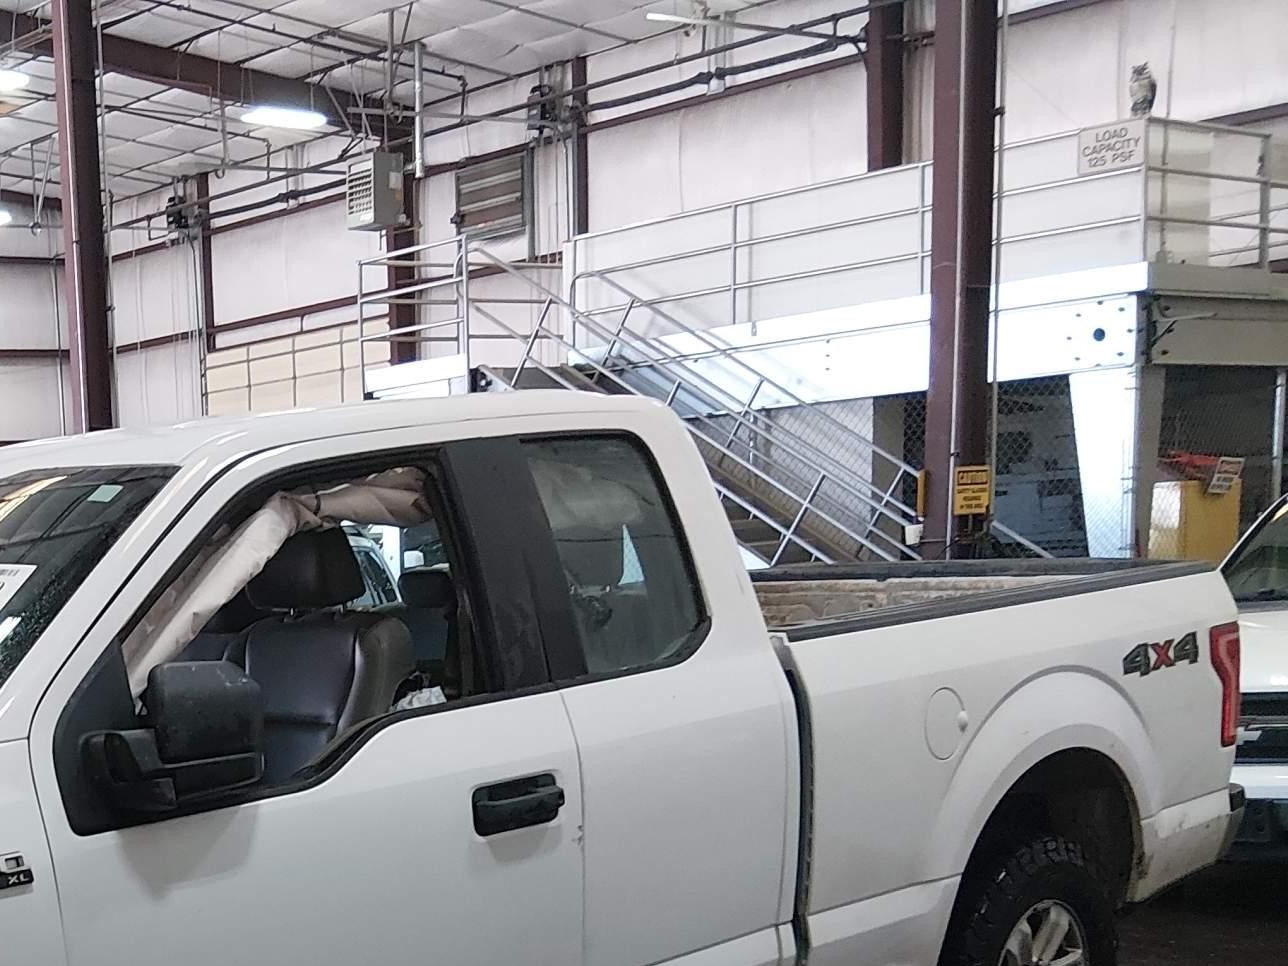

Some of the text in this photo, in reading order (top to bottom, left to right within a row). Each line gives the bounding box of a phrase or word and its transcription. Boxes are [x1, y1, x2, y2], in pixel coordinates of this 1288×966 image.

[1095, 127, 1129, 143] LOAD
[1082, 136, 1142, 158] CAPACITY
[1087, 149, 1136, 168] 125 PSF
[7, 872, 30, 885] XL
